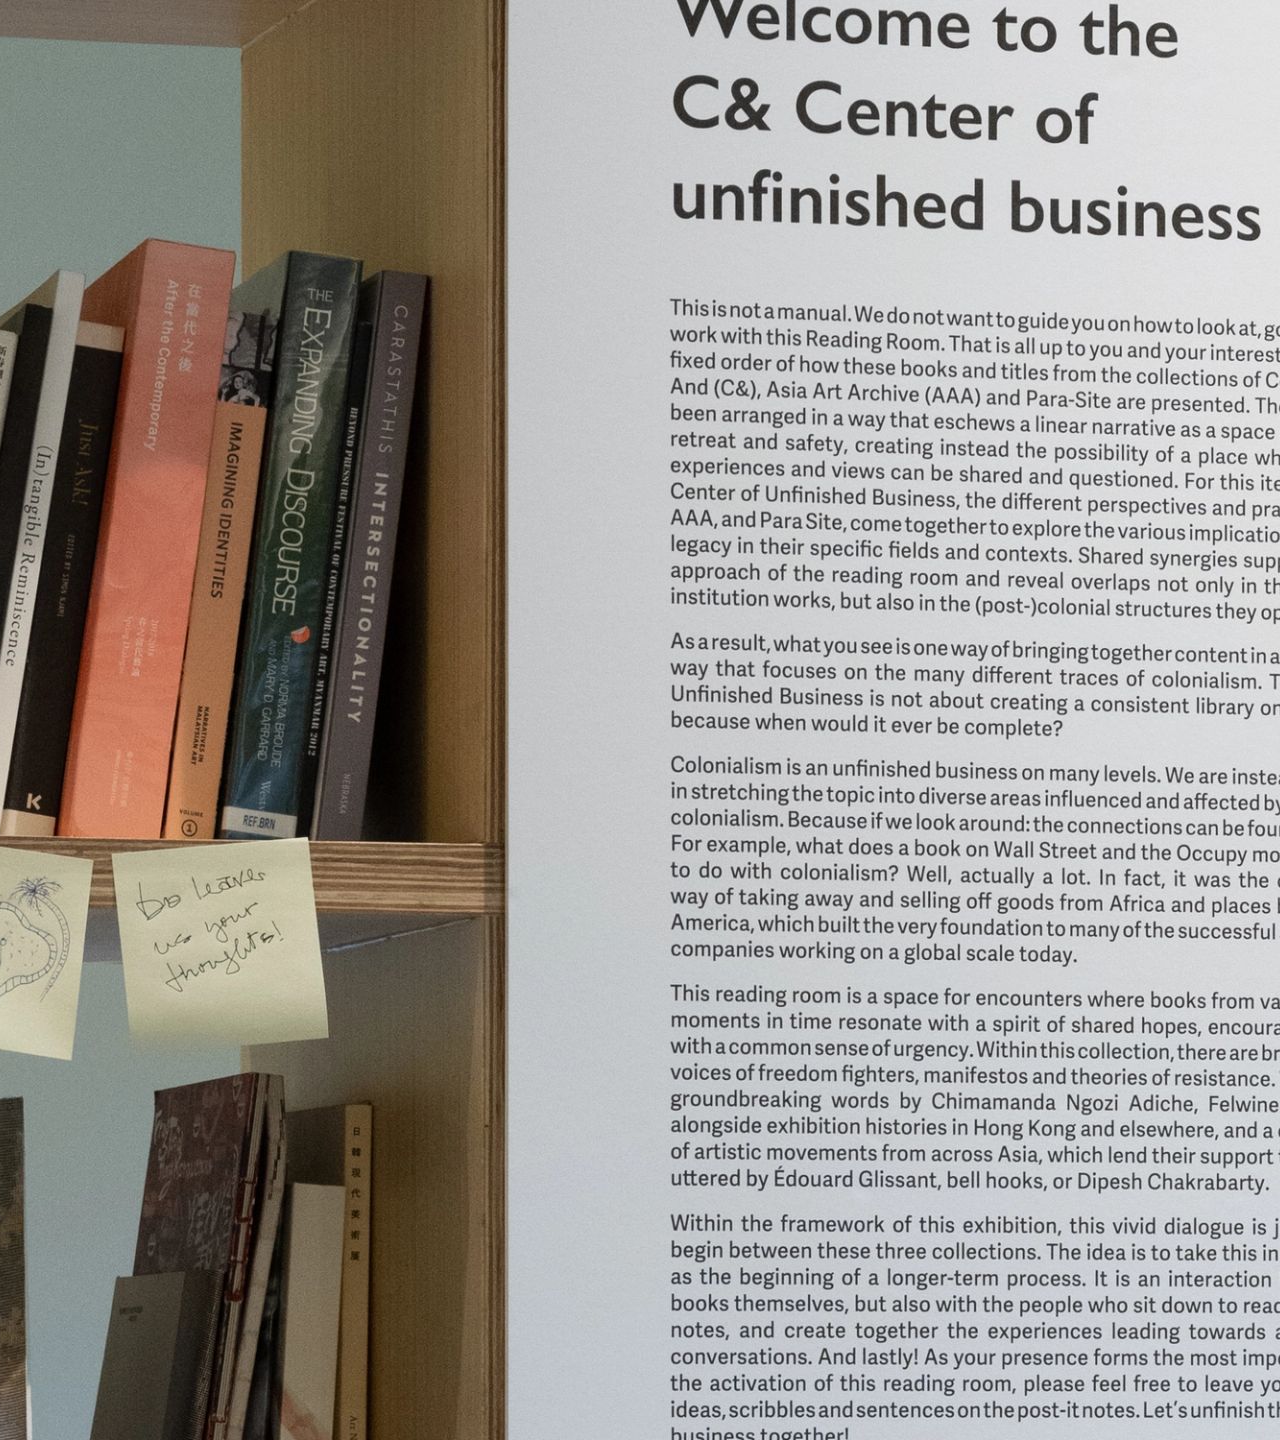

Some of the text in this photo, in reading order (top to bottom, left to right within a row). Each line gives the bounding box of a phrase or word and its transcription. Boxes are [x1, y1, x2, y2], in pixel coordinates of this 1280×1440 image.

[992, 7, 1056, 52] to
[1079, 4, 1177, 58] the
[673, 75, 1098, 144] C& Center of
[673, 169, 1260, 241] unfinished business
[144, 279, 178, 451] After the Contemporary
[670, 378, 707, 395] And
[714, 379, 760, 400] (C&),
[767, 381, 806, 398] Asia
[813, 382, 842, 399] Art
[848, 383, 919, 402] Archive
[925, 386, 980, 407] (AAA)
[986, 389, 1020, 405] and
[1027, 390, 1110, 408] Para-Site
[1116, 397, 1145, 410] are
[1152, 396, 1249, 414] presented.
[211, 422, 242, 597] IMAGINING IDENTITIES
[271, 306, 334, 616] EXPANDING DISCOURSE
[348, 472, 388, 722] INTERSECTIONALITY
